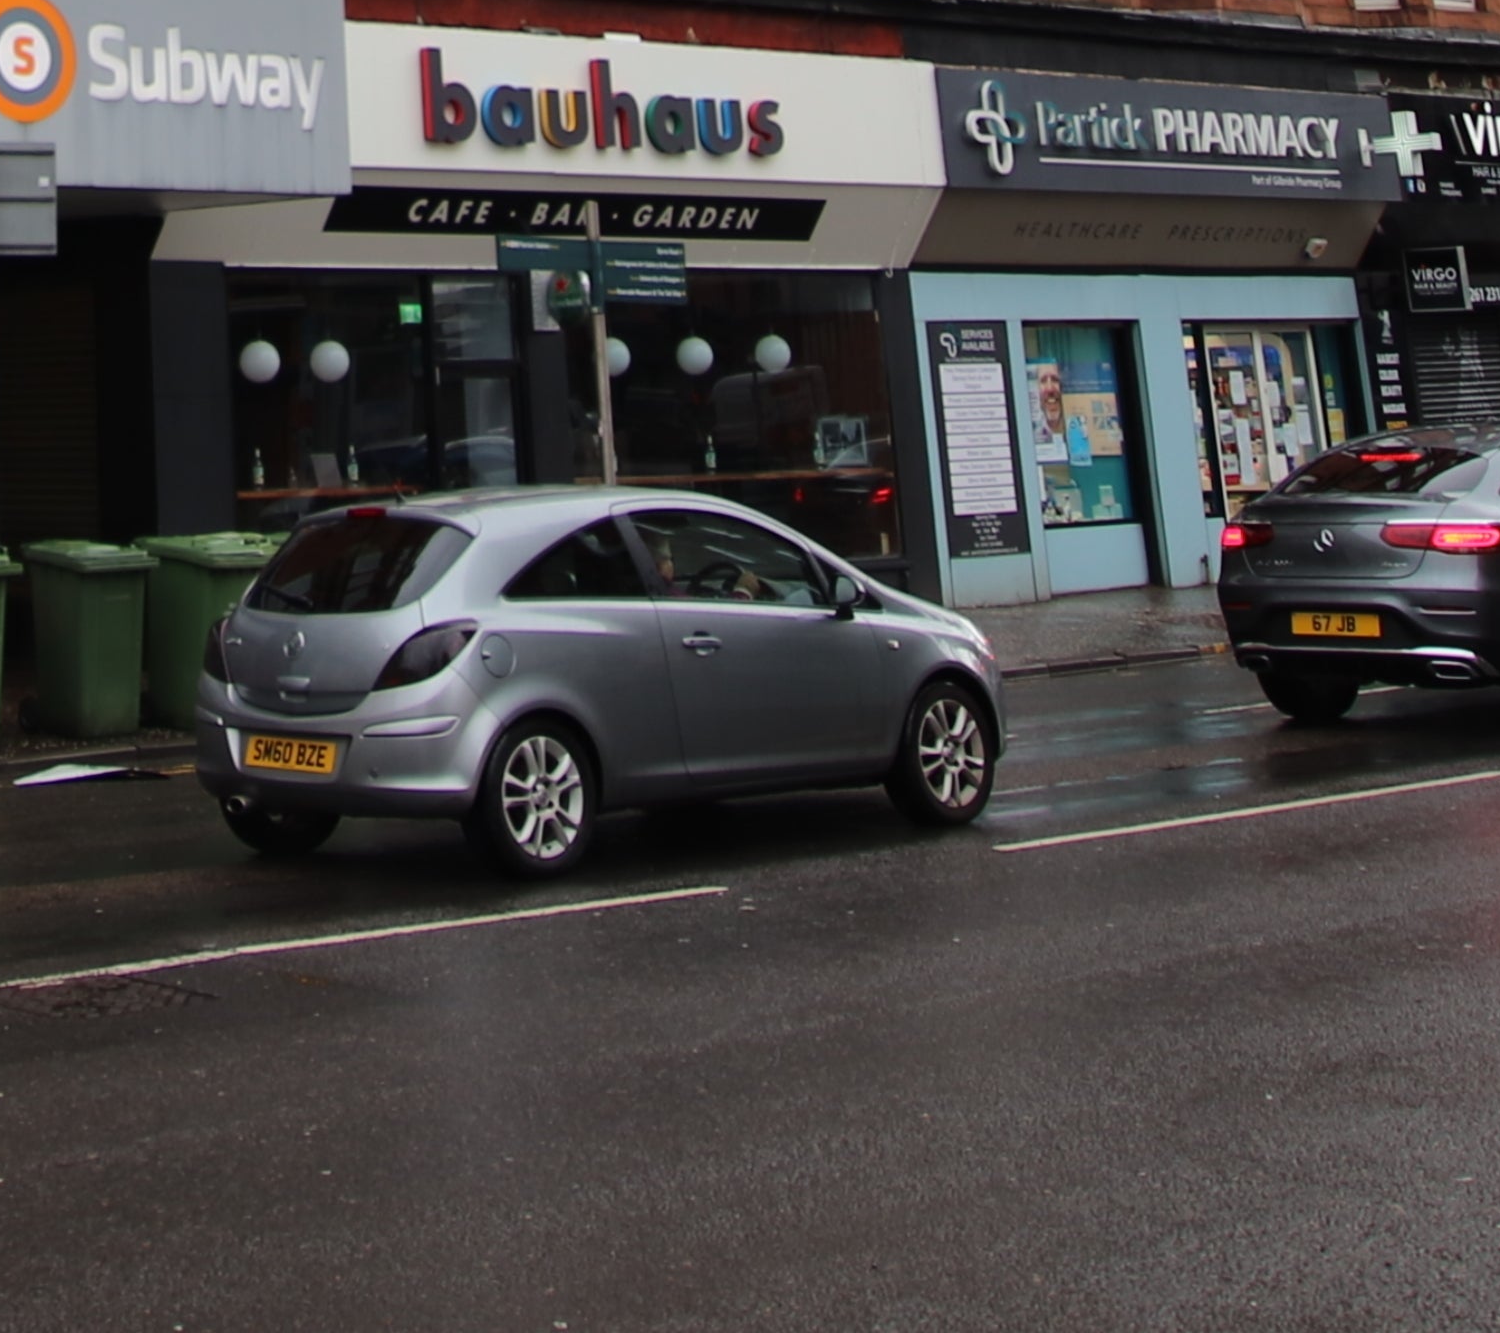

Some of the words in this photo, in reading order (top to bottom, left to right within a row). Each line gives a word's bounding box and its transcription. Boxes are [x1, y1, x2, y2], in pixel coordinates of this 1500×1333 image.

[87, 24, 324, 130] Subway
[419, 47, 784, 157] bauhaus
[1035, 101, 1150, 150] Partick
[1153, 108, 1338, 159] PHARMACY
[408, 198, 494, 225] CAFE
[632, 205, 760, 231] GARDEN
[1016, 221, 1141, 239] HEALTHCARE
[1312, 615, 1330, 633] 67
[1337, 615, 1356, 633] JB
[253, 739, 293, 764] SM60
[296, 743, 329, 768] BZE
